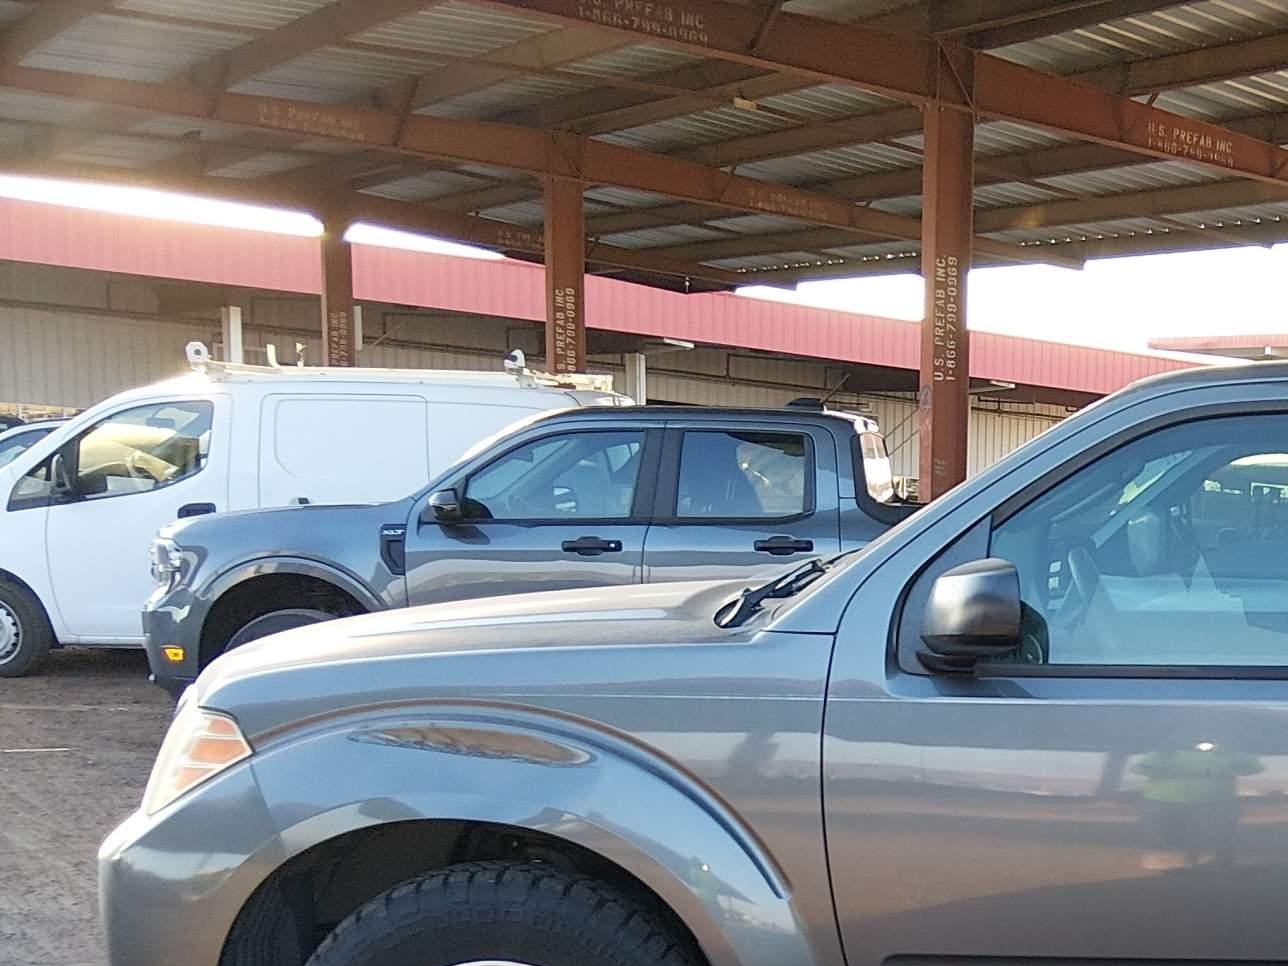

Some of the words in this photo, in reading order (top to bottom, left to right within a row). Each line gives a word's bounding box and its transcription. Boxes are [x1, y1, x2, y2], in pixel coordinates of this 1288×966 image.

[1173, 127, 1213, 149] PREFAB
[555, 312, 566, 354] PREFAB
[934, 289, 946, 346] PREFAB
[946, 256, 958, 381] 1-866-799-0969
